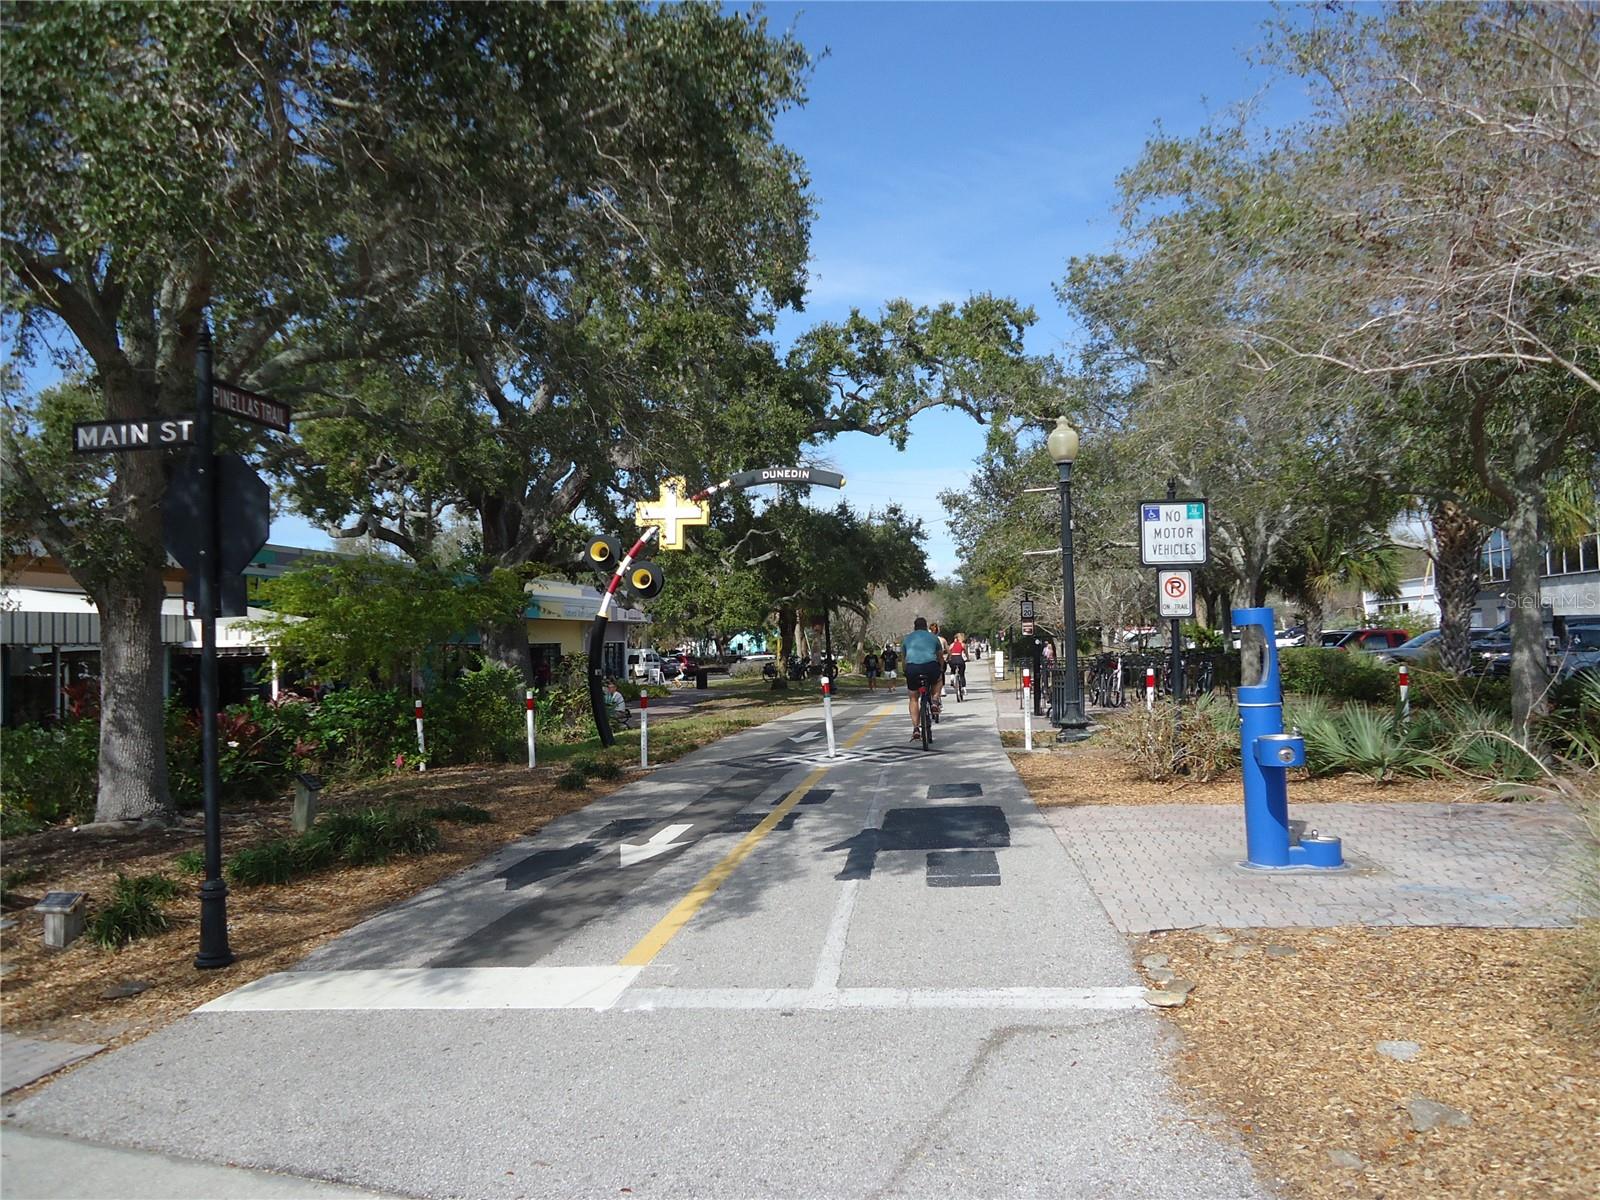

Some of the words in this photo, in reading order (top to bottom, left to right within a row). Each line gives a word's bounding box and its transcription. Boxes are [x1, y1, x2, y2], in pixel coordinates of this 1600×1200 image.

[212, 386, 260, 419] PINELLAS
[261, 402, 287, 427] TRAIL
[77, 423, 149, 448] MAIN
[159, 420, 194, 442] ST
[762, 469, 810, 480] DUNEDIN
[1165, 510, 1181, 522] NO
[1153, 527, 1194, 539] MOTOR
[1152, 543, 1197, 556] VEHICLES
